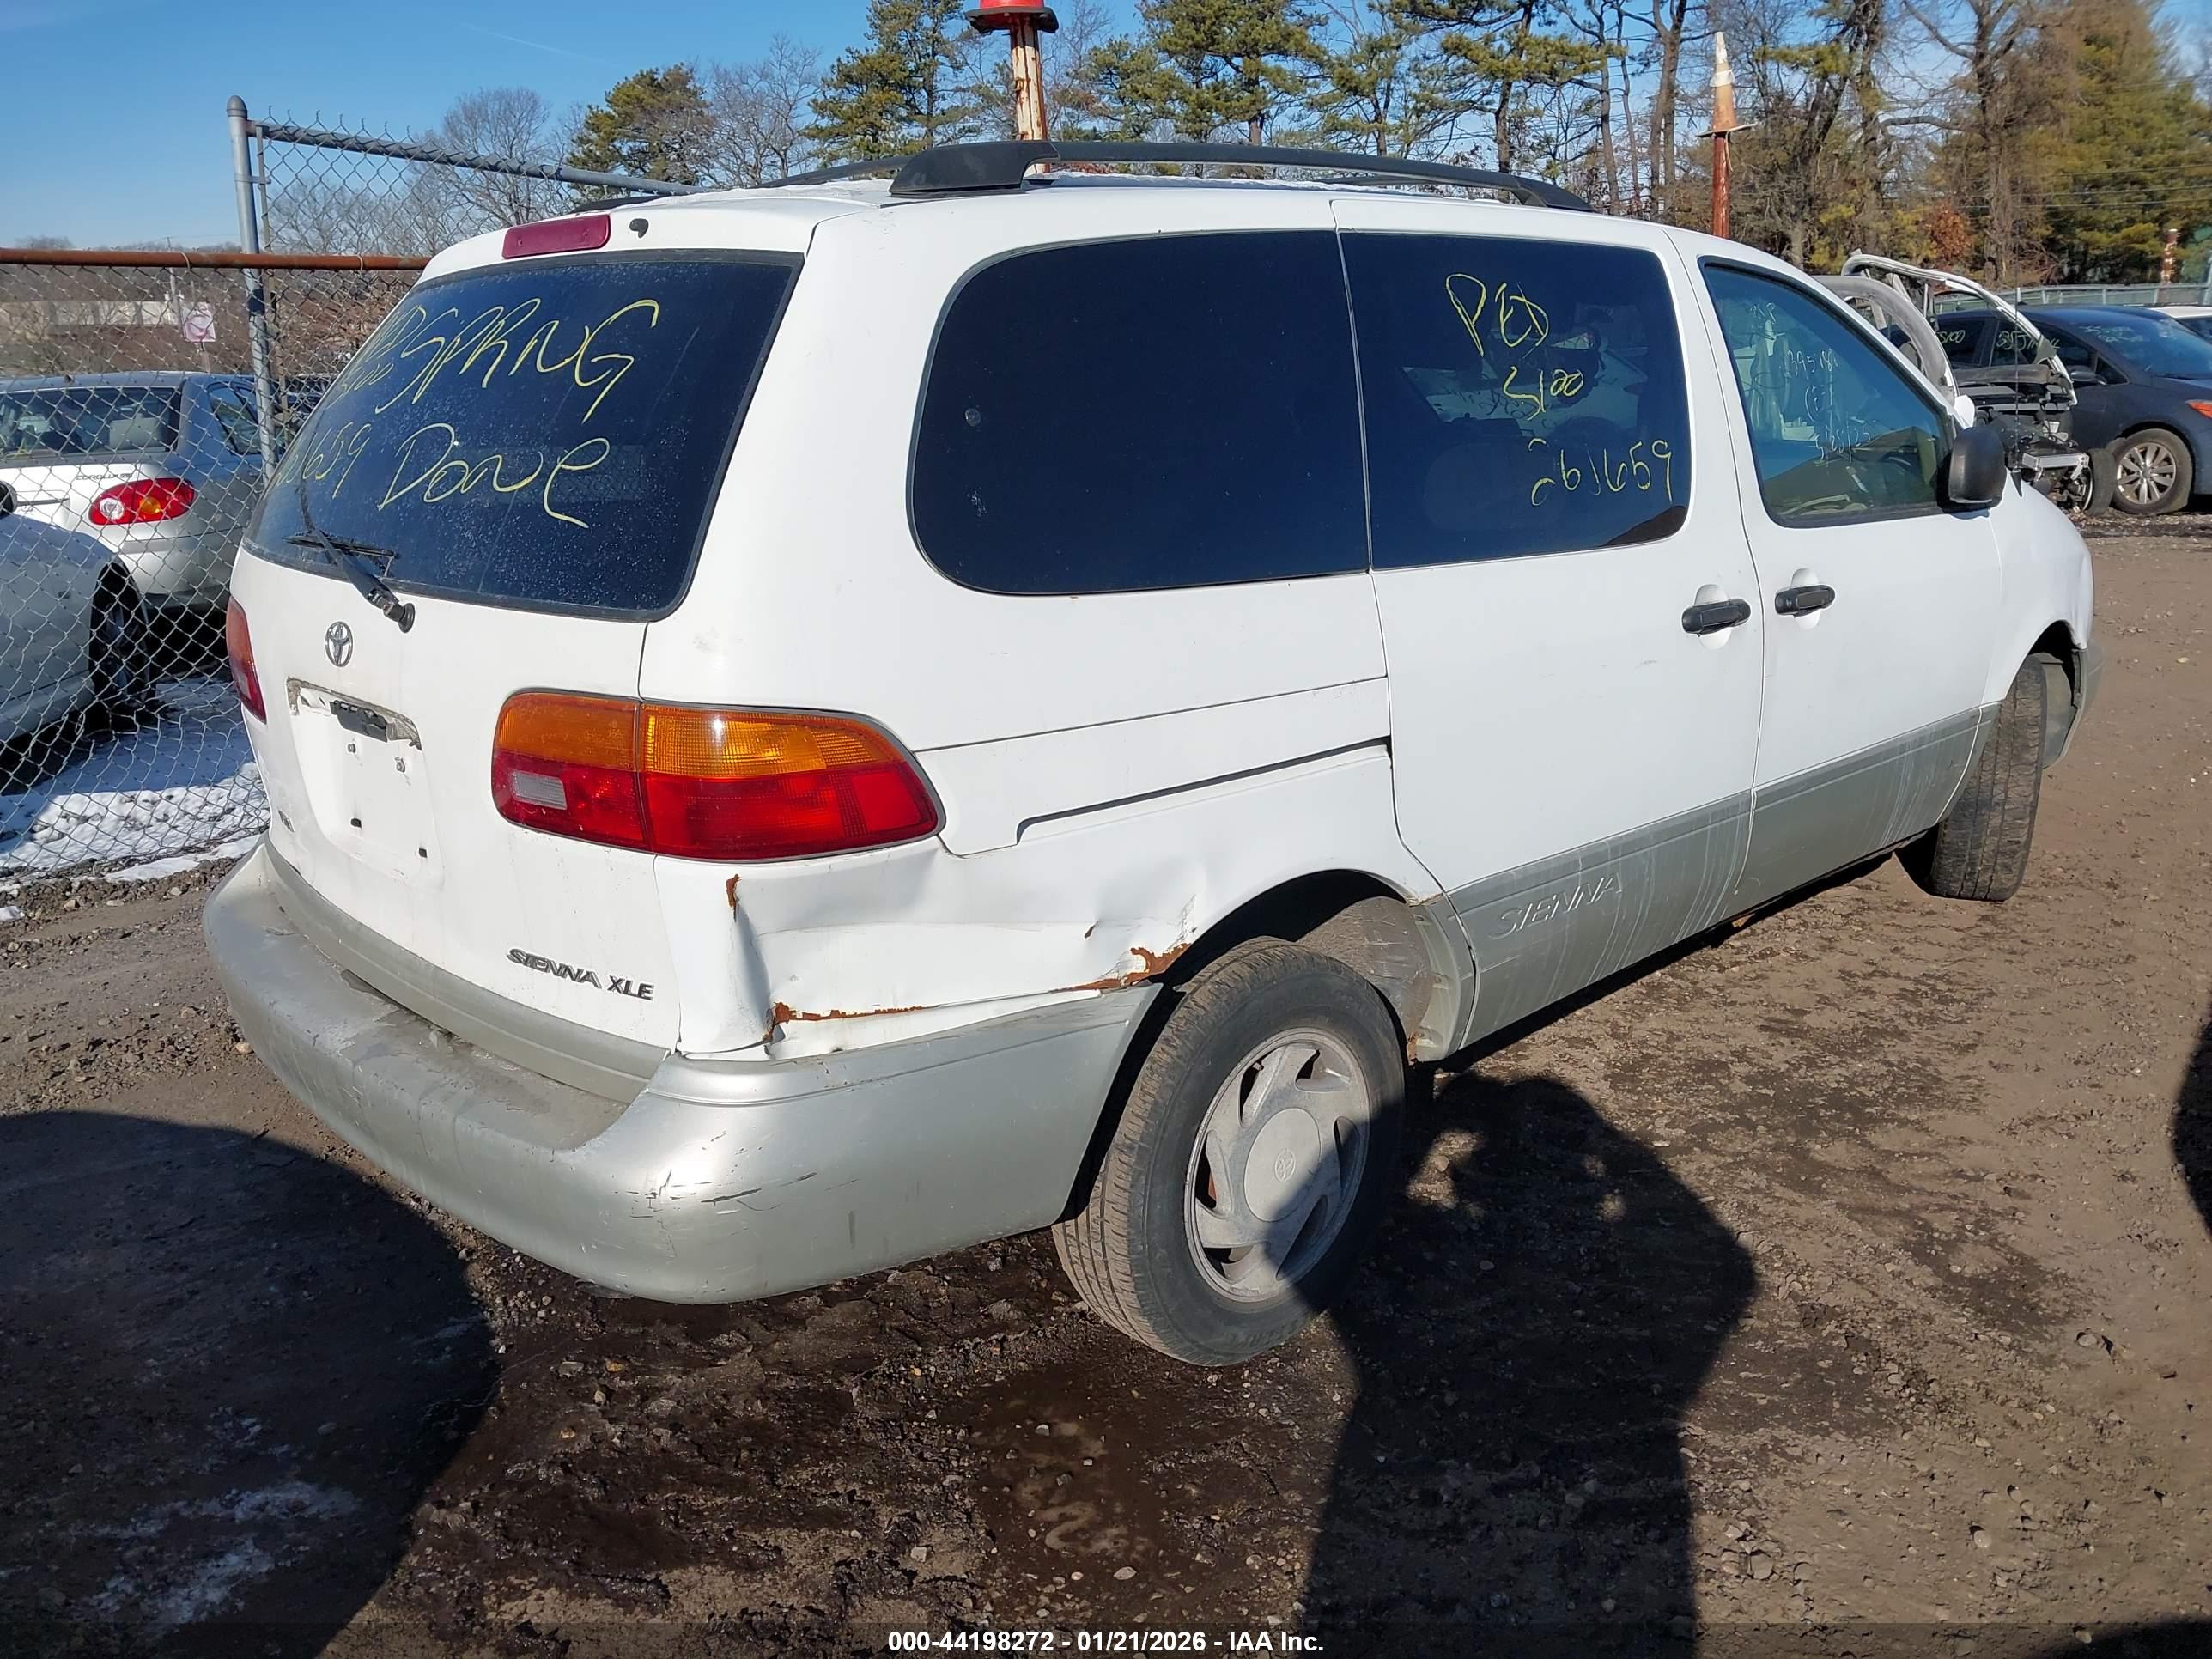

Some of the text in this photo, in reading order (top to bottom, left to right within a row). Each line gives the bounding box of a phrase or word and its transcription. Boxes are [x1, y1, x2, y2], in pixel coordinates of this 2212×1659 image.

[1531, 440, 1673, 507] 261659
[1487, 872, 1622, 939] SIENNA
[507, 948, 654, 1000] SIENNA XLE
